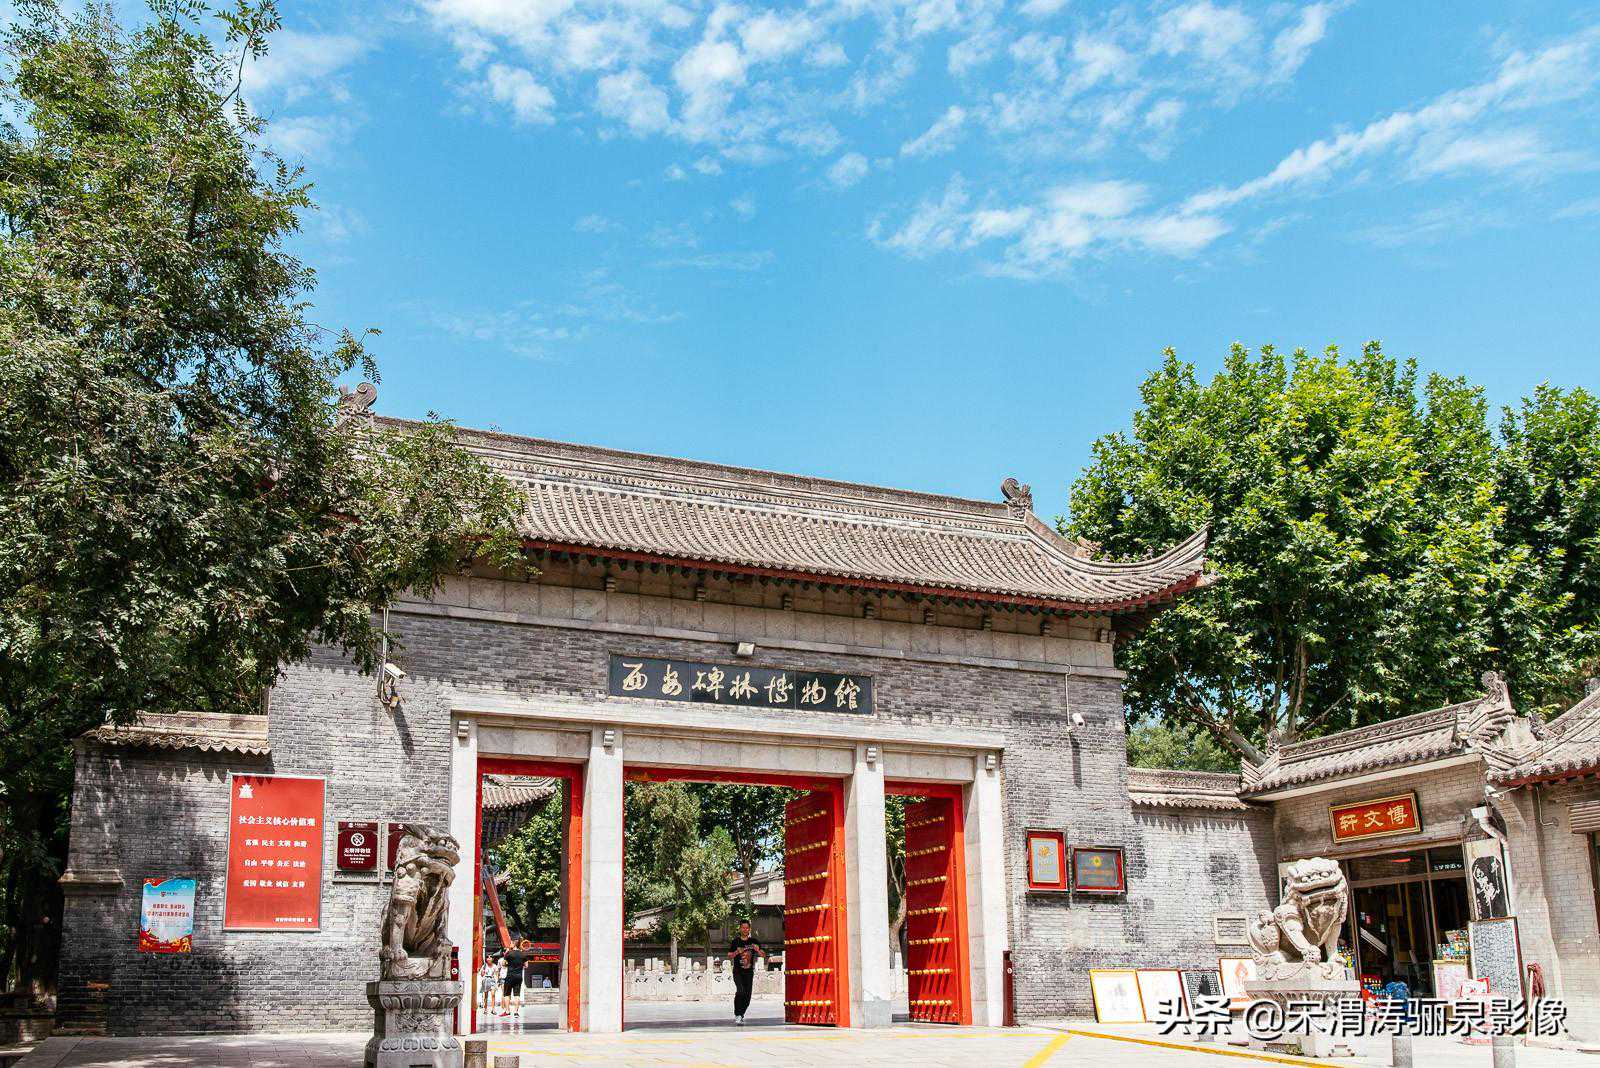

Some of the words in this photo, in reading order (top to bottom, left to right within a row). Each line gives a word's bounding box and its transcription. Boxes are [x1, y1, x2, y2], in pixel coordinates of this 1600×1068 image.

[239, 815, 316, 826] 社会主义核心价值观
